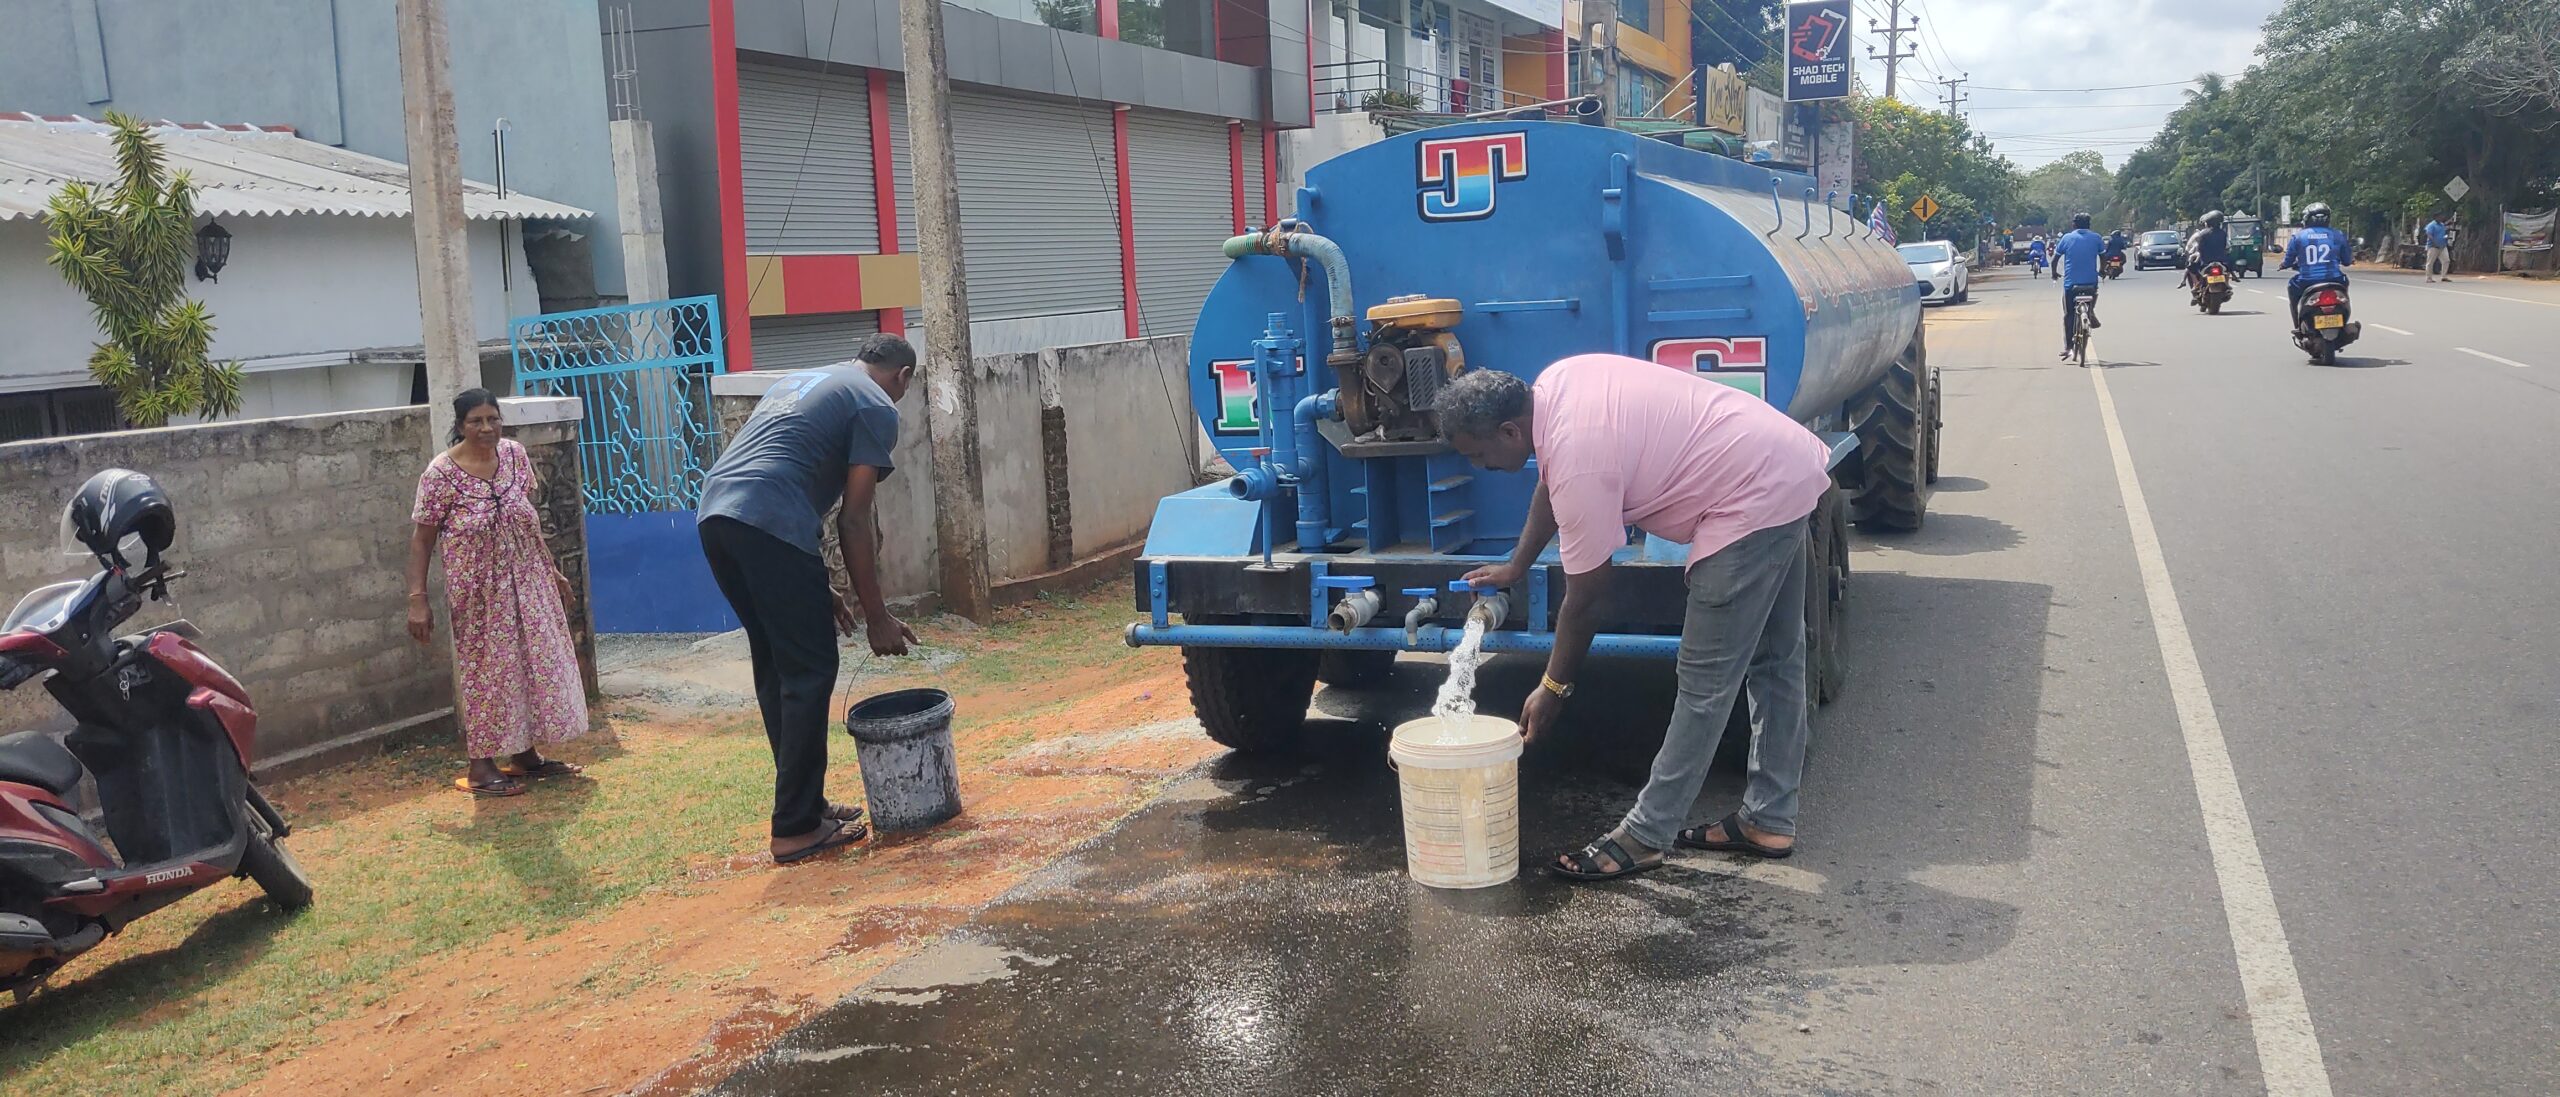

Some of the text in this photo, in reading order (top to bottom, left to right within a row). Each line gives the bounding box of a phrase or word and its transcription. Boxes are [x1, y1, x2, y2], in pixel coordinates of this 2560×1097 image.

[1793, 62, 1845, 76] SHAD TECH
[1800, 73, 1838, 85] MOBILE
[2305, 243, 2331, 265] 02
[146, 866, 194, 884] HONDA
